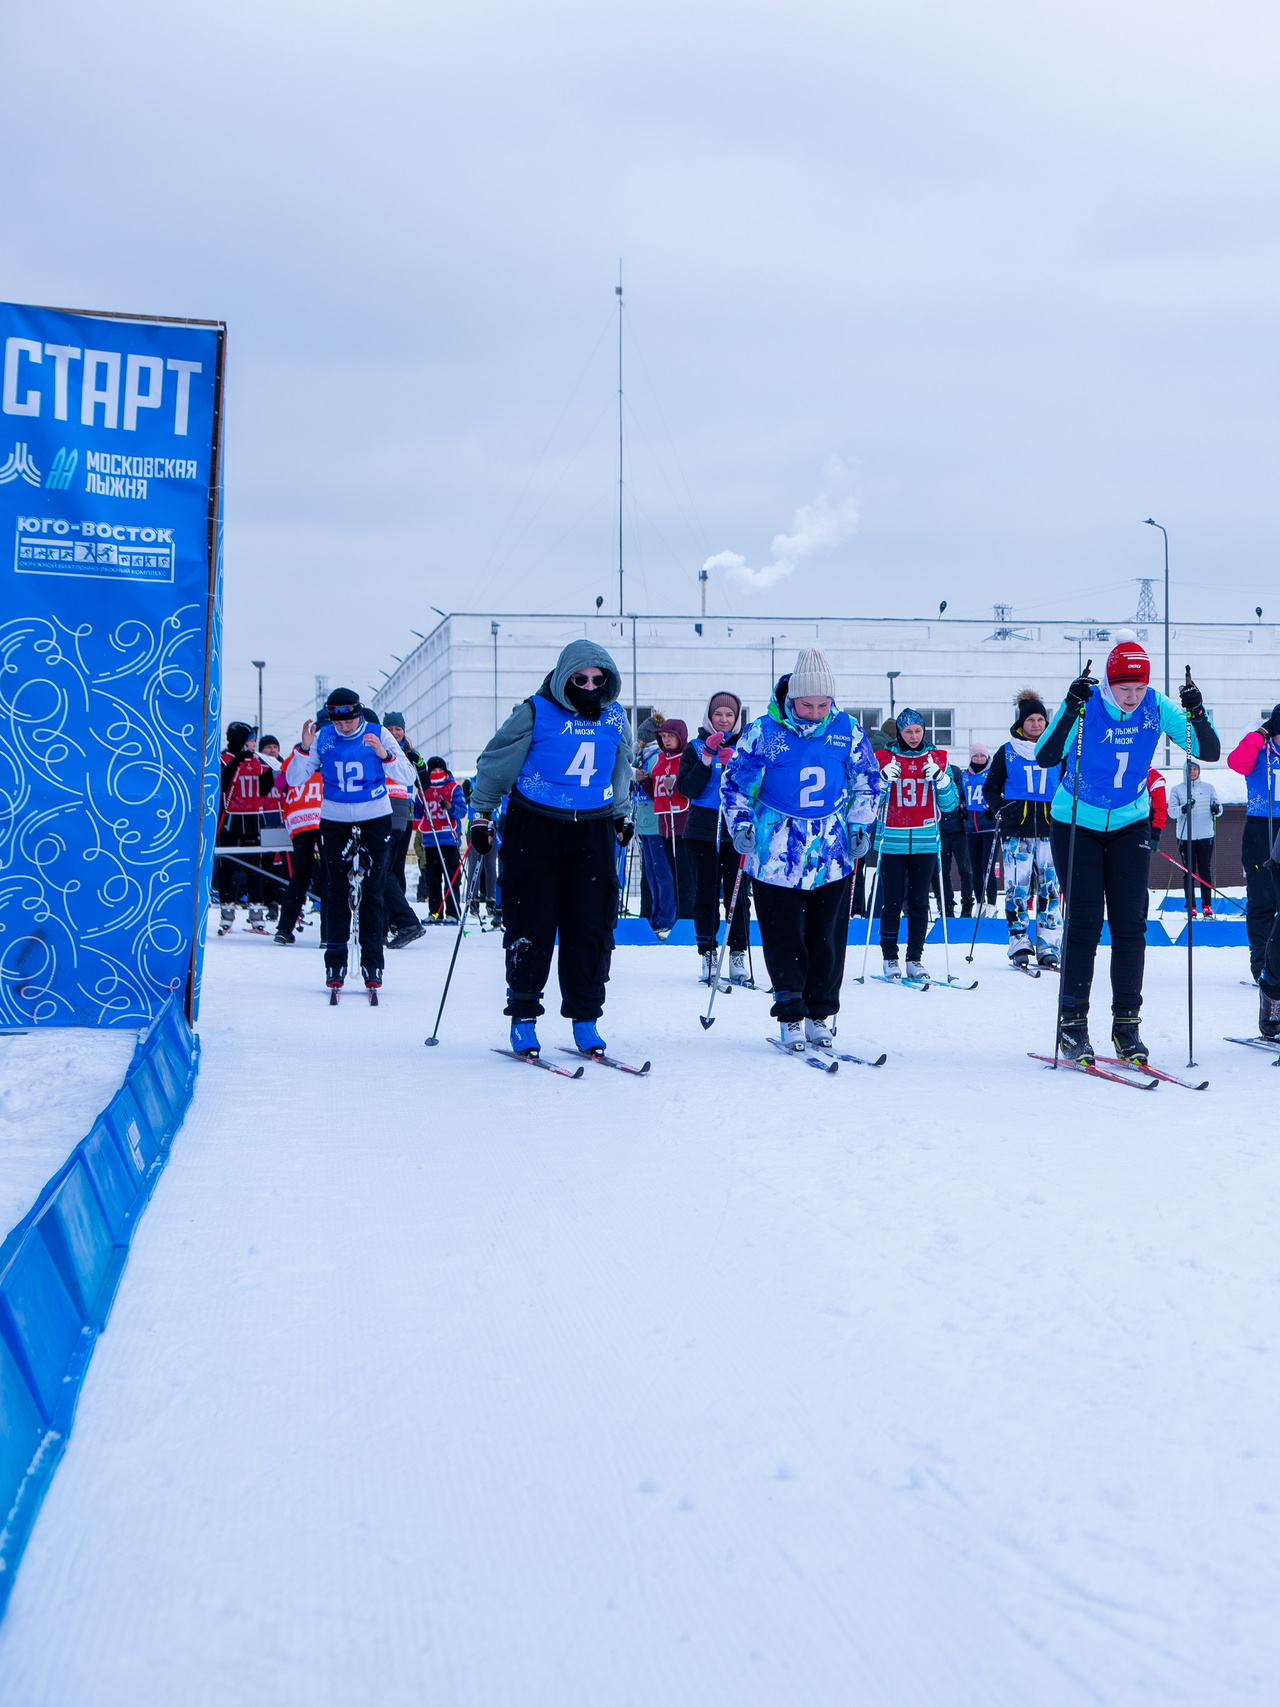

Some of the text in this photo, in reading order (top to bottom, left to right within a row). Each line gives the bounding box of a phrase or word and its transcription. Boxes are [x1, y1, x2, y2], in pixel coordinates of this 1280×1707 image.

[2, 336, 203, 436] СТАРТ
[86, 450, 197, 479] МОСКОВСКАЯ
[85, 472, 148, 499] ЛЫЖНЯ
[17, 516, 174, 543] ЮГО-ВОСТОК
[131, 568, 167, 577] КОМПЛЕКС
[574, 719, 602, 727] ЛЫЖНЯ
[1115, 726, 1139, 735] ЛЫЖНЯ
[1115, 737, 1134, 745] МОЭК
[334, 761, 364, 792] 12
[564, 742, 598, 787] 4
[1114, 752, 1129, 788] 1
[800, 766, 826, 808] 2
[895, 778, 930, 807] 137
[1023, 765, 1048, 794] 17
[967, 785, 983, 805] 14
